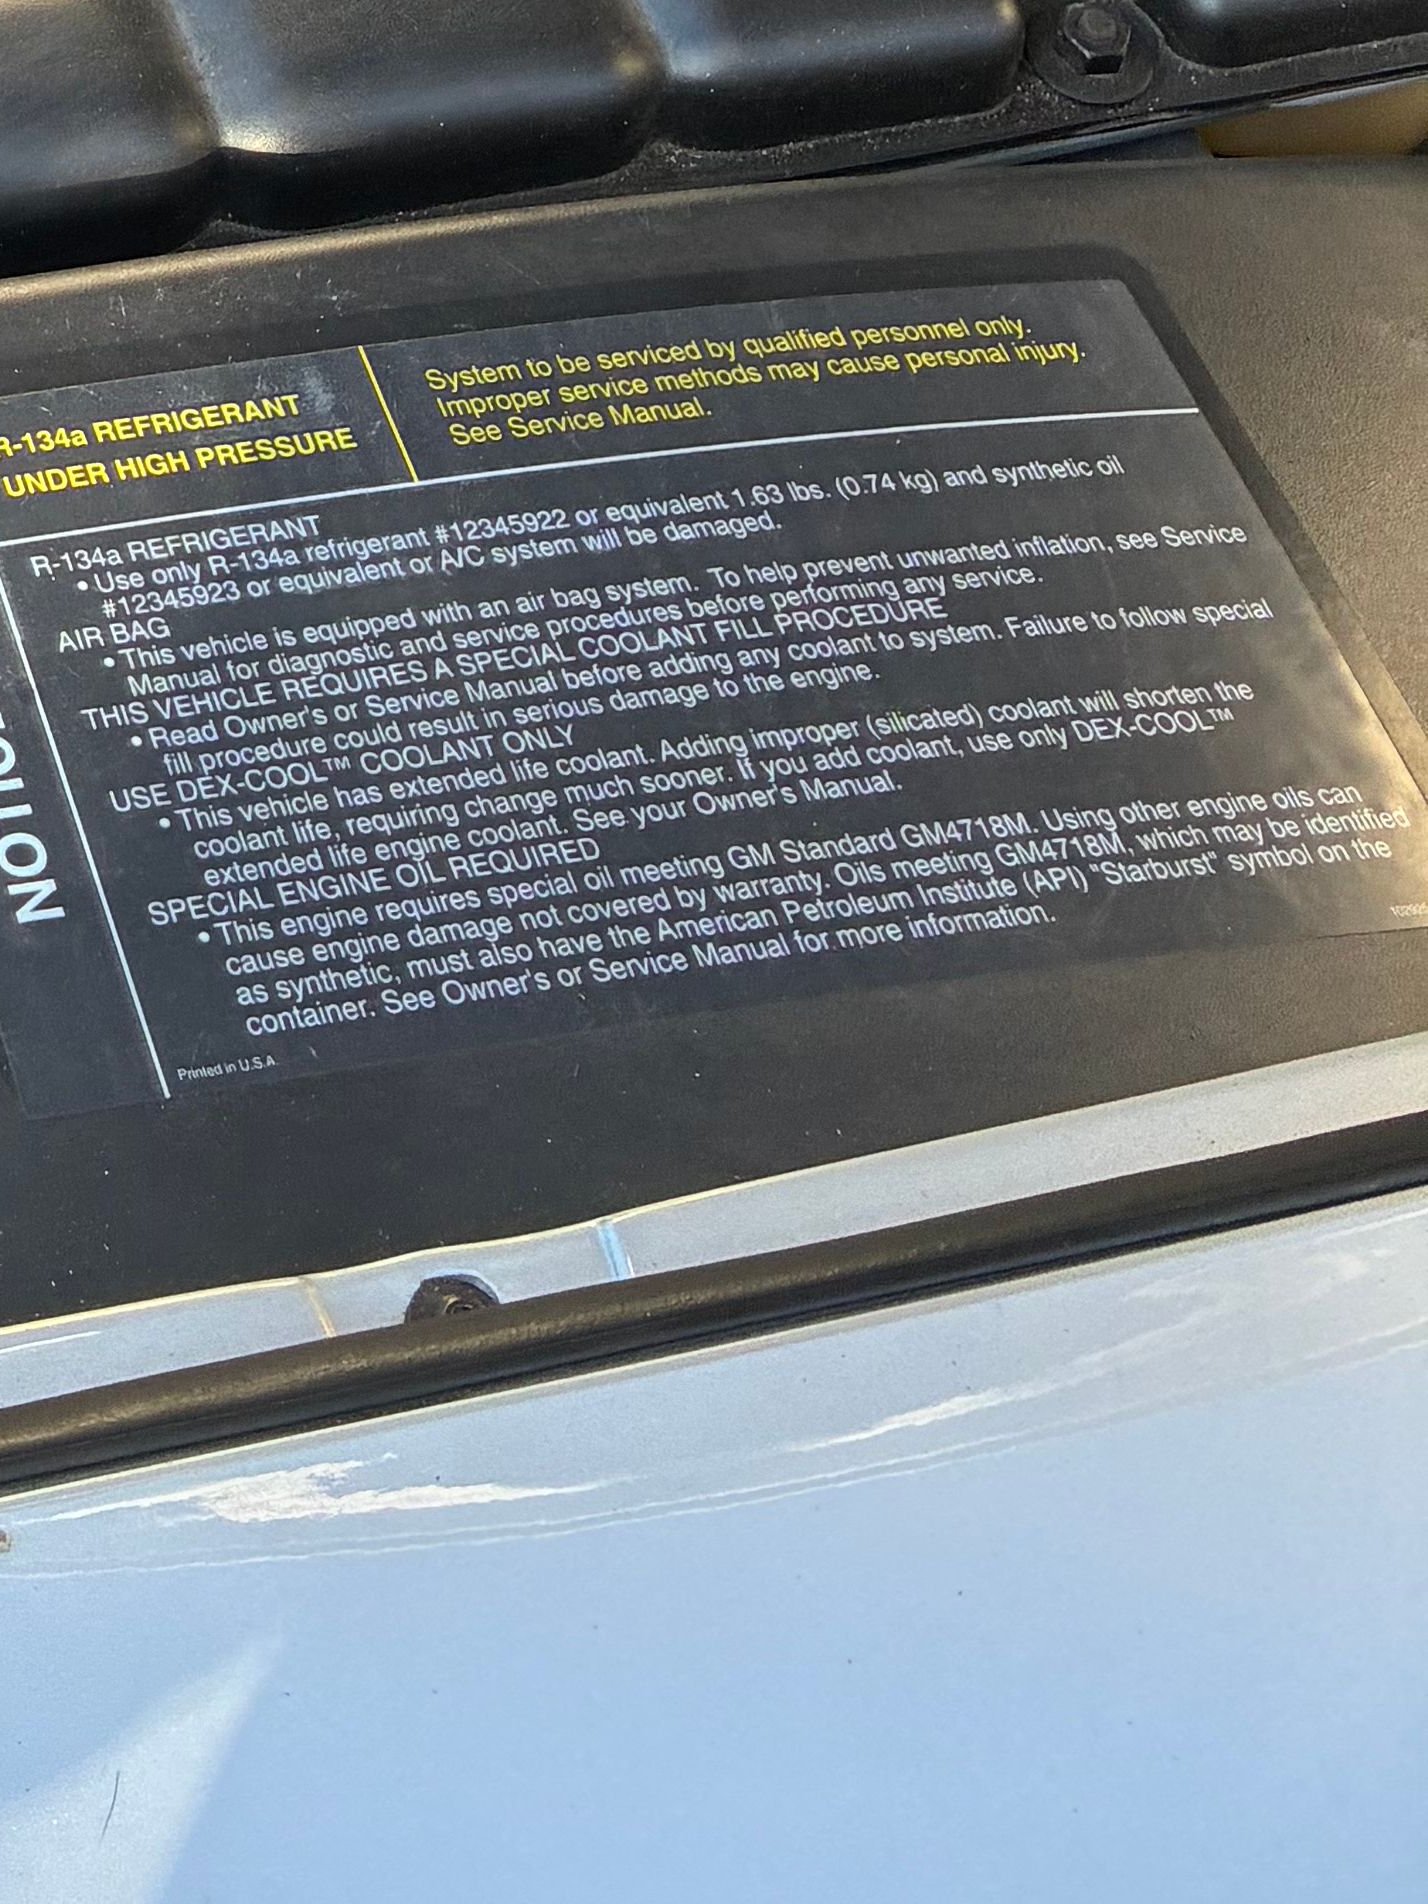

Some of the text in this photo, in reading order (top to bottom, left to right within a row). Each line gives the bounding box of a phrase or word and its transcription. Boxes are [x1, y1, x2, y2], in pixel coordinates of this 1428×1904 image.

[424, 315, 1032, 393] System to be serviced by qualified personnel only.
[435, 341, 1087, 418] Improper service methods may cause personal injury.
[91, 393, 299, 443] REFRIGERANT
[448, 397, 713, 446] See Service Manual.
[1, 426, 358, 498] UNDER HIGH PRESSURE
[28, 514, 320, 579] R-134a REFRIGERANT
[92, 454, 1126, 594] Use only R-134a refrigerant #12345922 or equivalent 1.63 lbs. (0.74 kg) and synthetic oil
[58, 616, 172, 654] AIR BAG
[79, 596, 949, 731] THIS VEHICLE REQUIRES A SPECIAL COOLANT FILL PROCEDURE
[108, 782, 173, 813] USE
[359, 734, 494, 776] COOLANT
[501, 723, 574, 755] ONLY
[146, 836, 601, 927] SPECIAL ENGINE OIL REQUIRED
[176, 1063, 224, 1082] Printed
[222, 1062, 238, 1075] in
